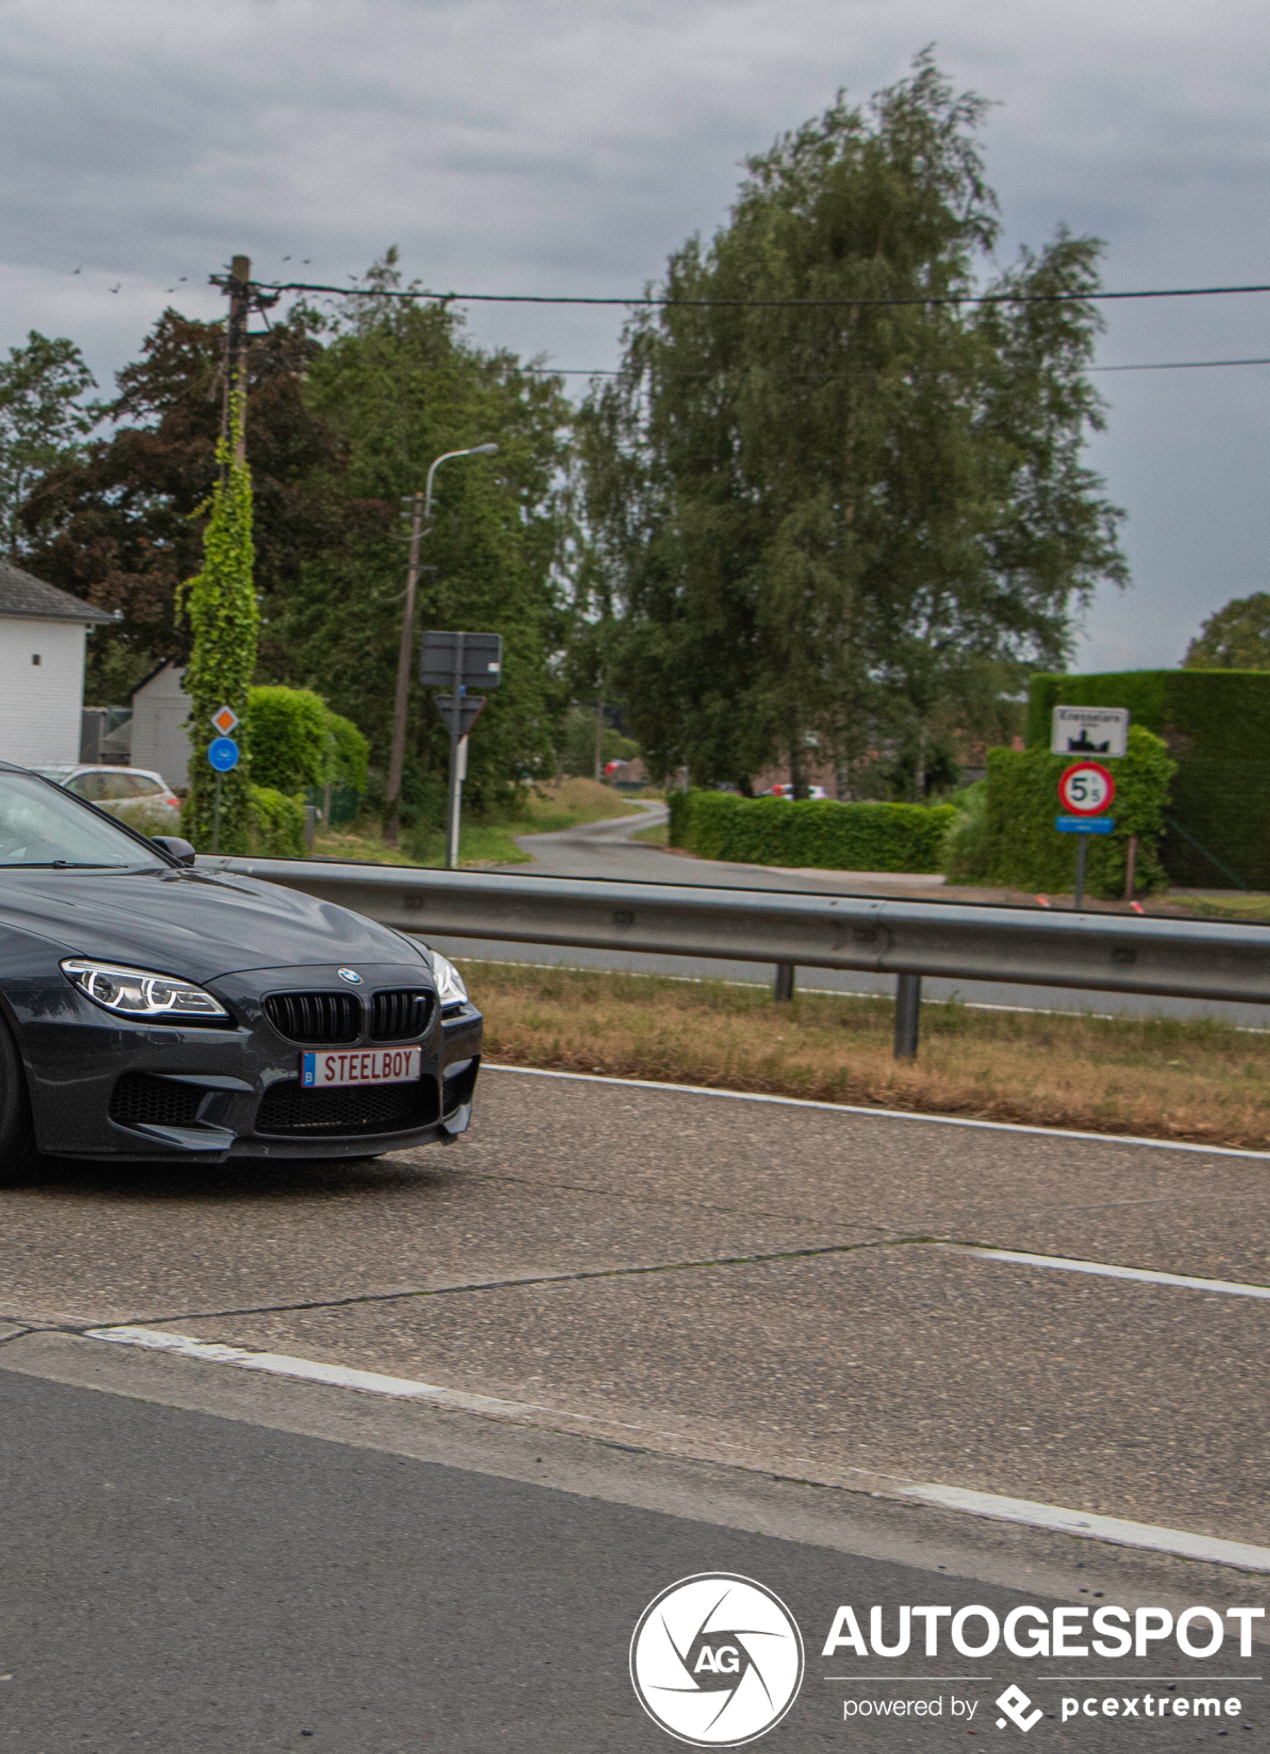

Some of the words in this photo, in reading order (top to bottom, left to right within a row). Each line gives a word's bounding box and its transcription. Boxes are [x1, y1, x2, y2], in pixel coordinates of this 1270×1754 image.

[1071, 777, 1087, 801] 5
[305, 1072, 313, 1083] B
[324, 1051, 412, 1081] STEELBOY
